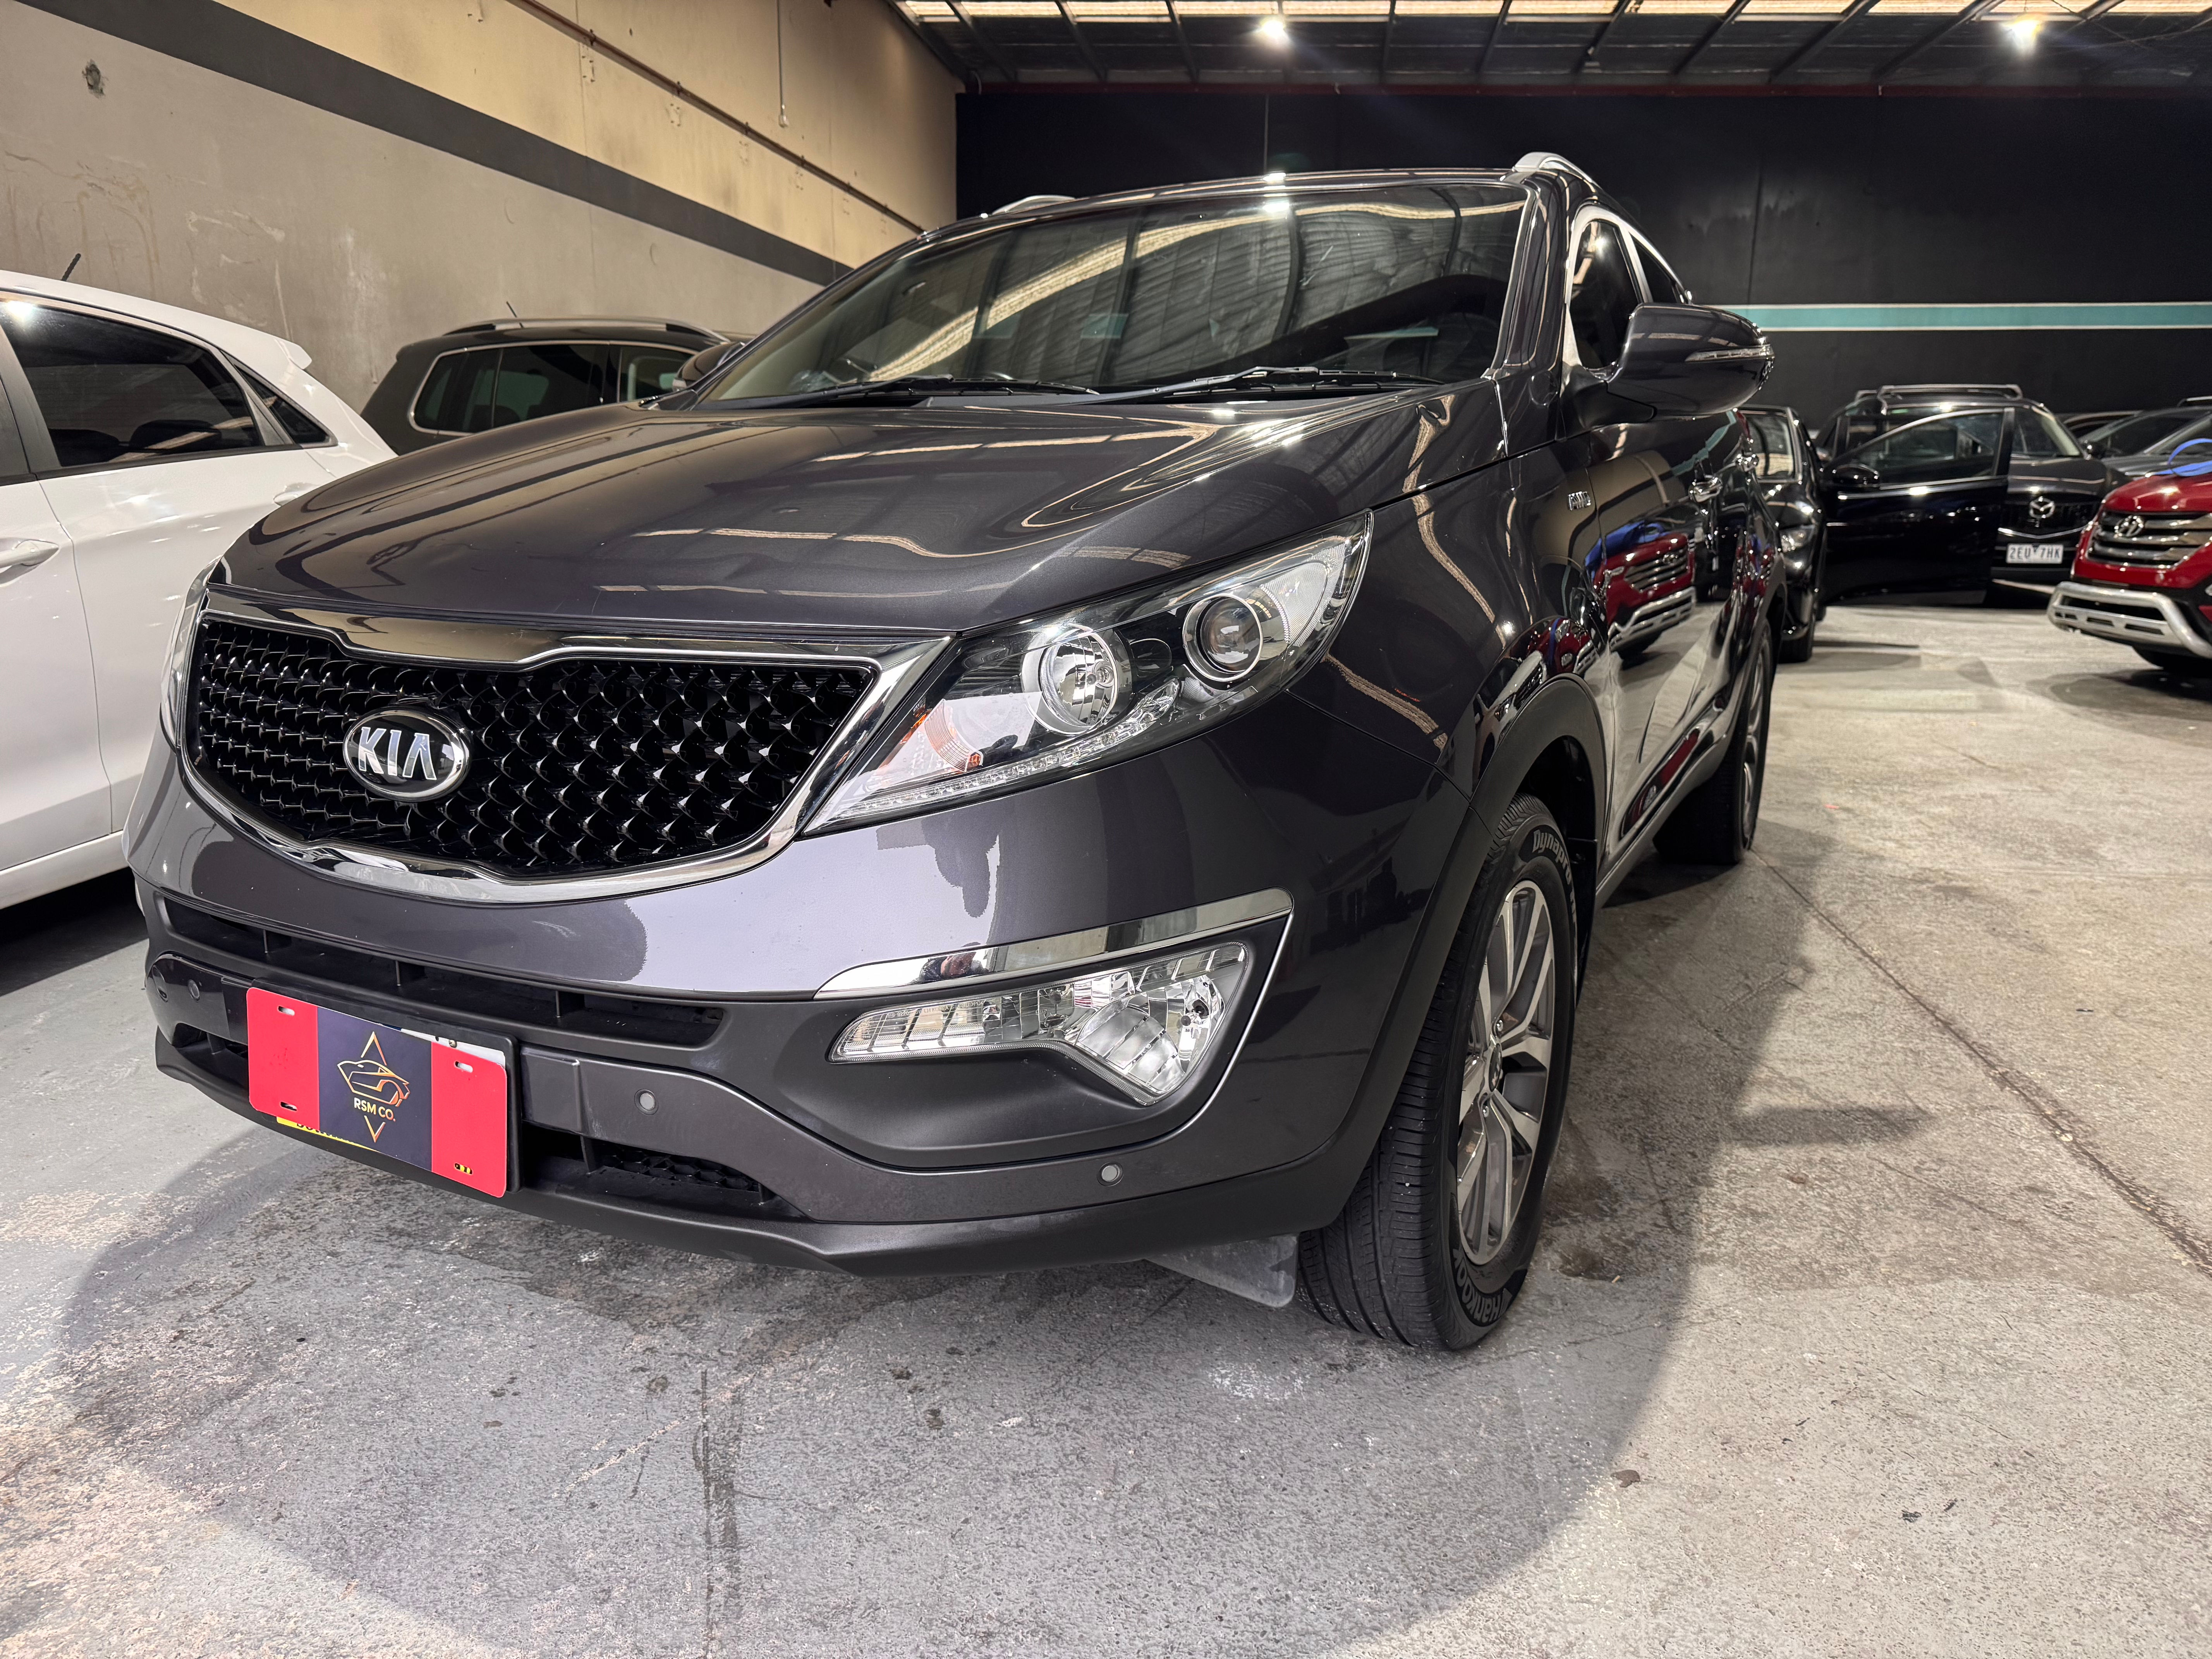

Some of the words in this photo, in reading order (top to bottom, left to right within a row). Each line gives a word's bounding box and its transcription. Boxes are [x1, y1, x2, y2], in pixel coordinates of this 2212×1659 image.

[358, 726, 437, 781] KIA
[1532, 830, 1572, 885] Dynapro
[354, 1097, 376, 1115] RSM
[378, 1106, 396, 1122] CO.
[1453, 1249, 1502, 1323] Hankook
